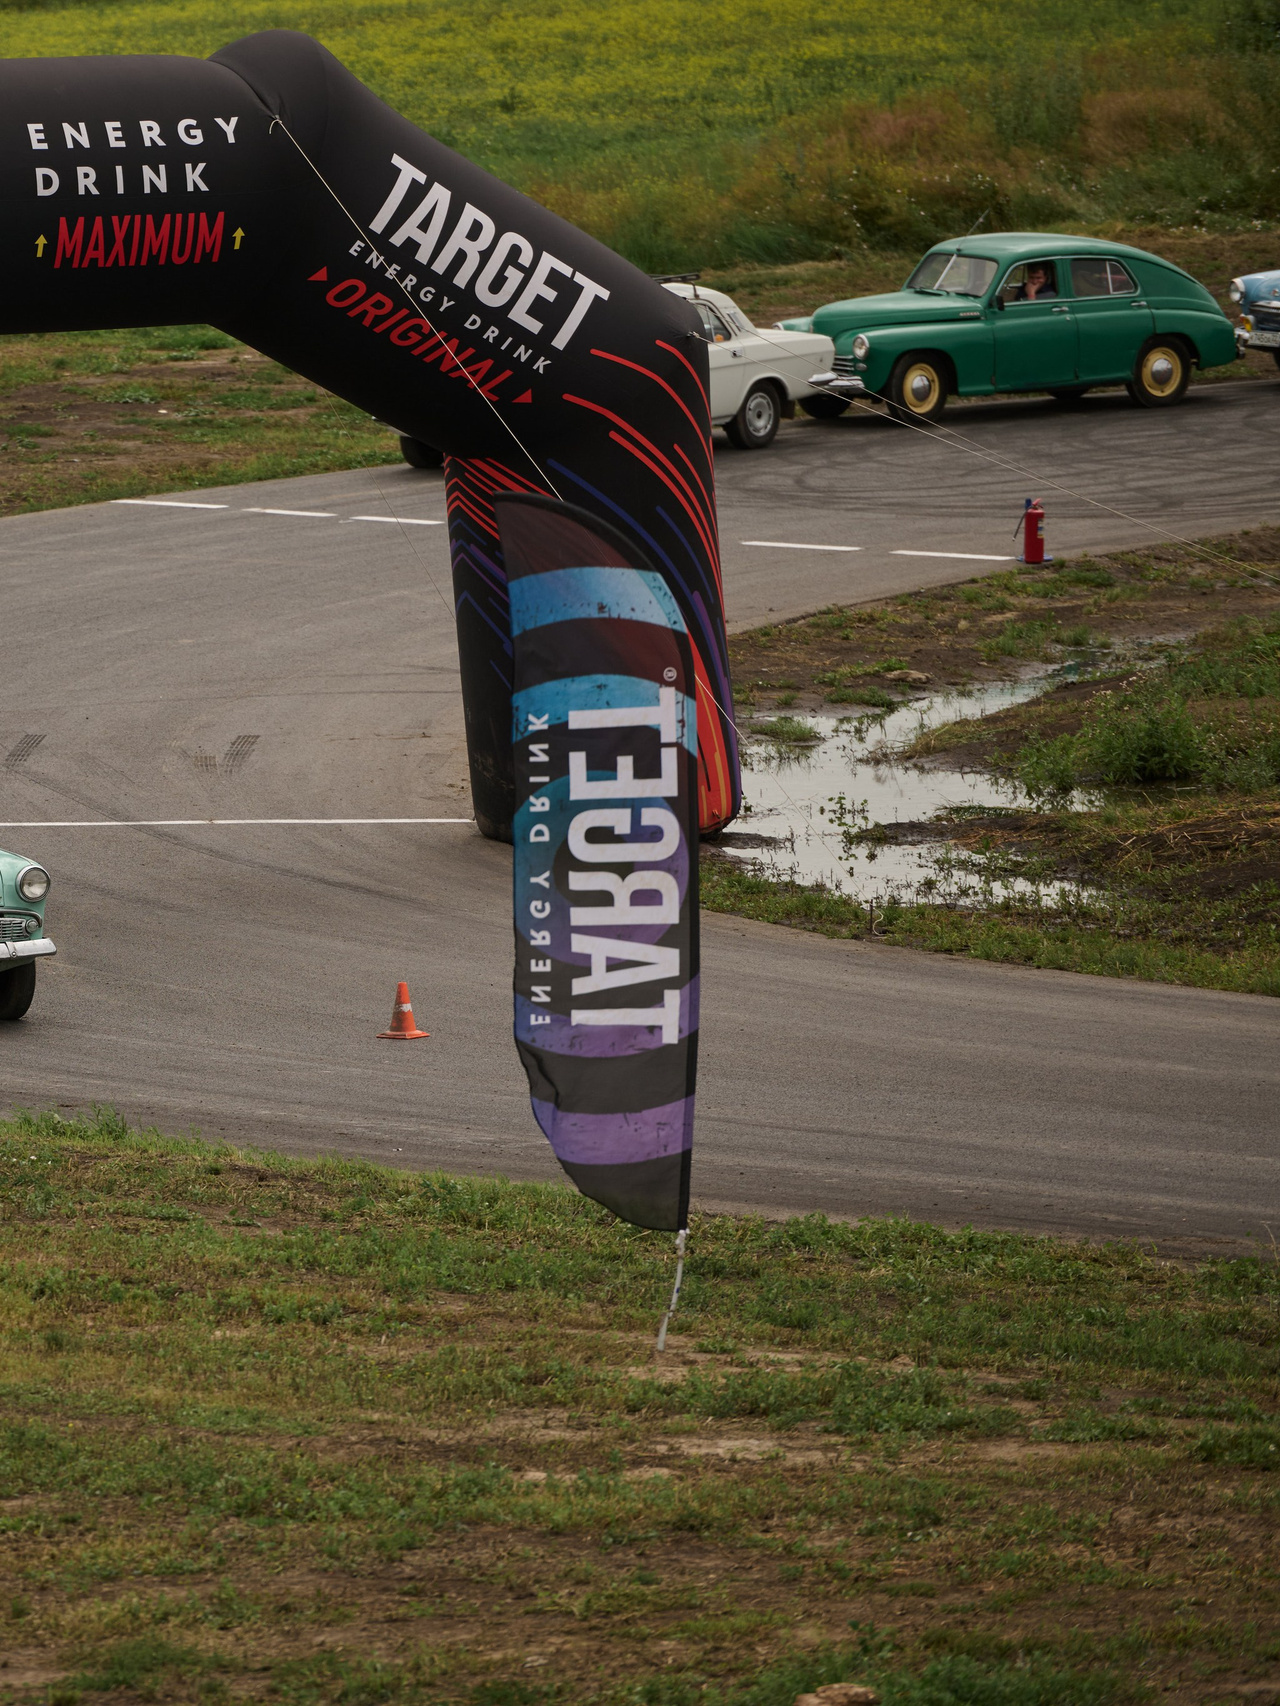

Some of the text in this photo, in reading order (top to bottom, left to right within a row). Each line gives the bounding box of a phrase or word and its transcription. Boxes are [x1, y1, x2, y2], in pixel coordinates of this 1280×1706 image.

[26, 116, 239, 150] ENERGY
[35, 162, 209, 197] DRINK
[53, 211, 225, 269] MAXIMUM
[368, 153, 611, 351] TARGET
[325, 278, 514, 402] ORIGINAL
[348, 240, 552, 374] ENERGY DRINK
